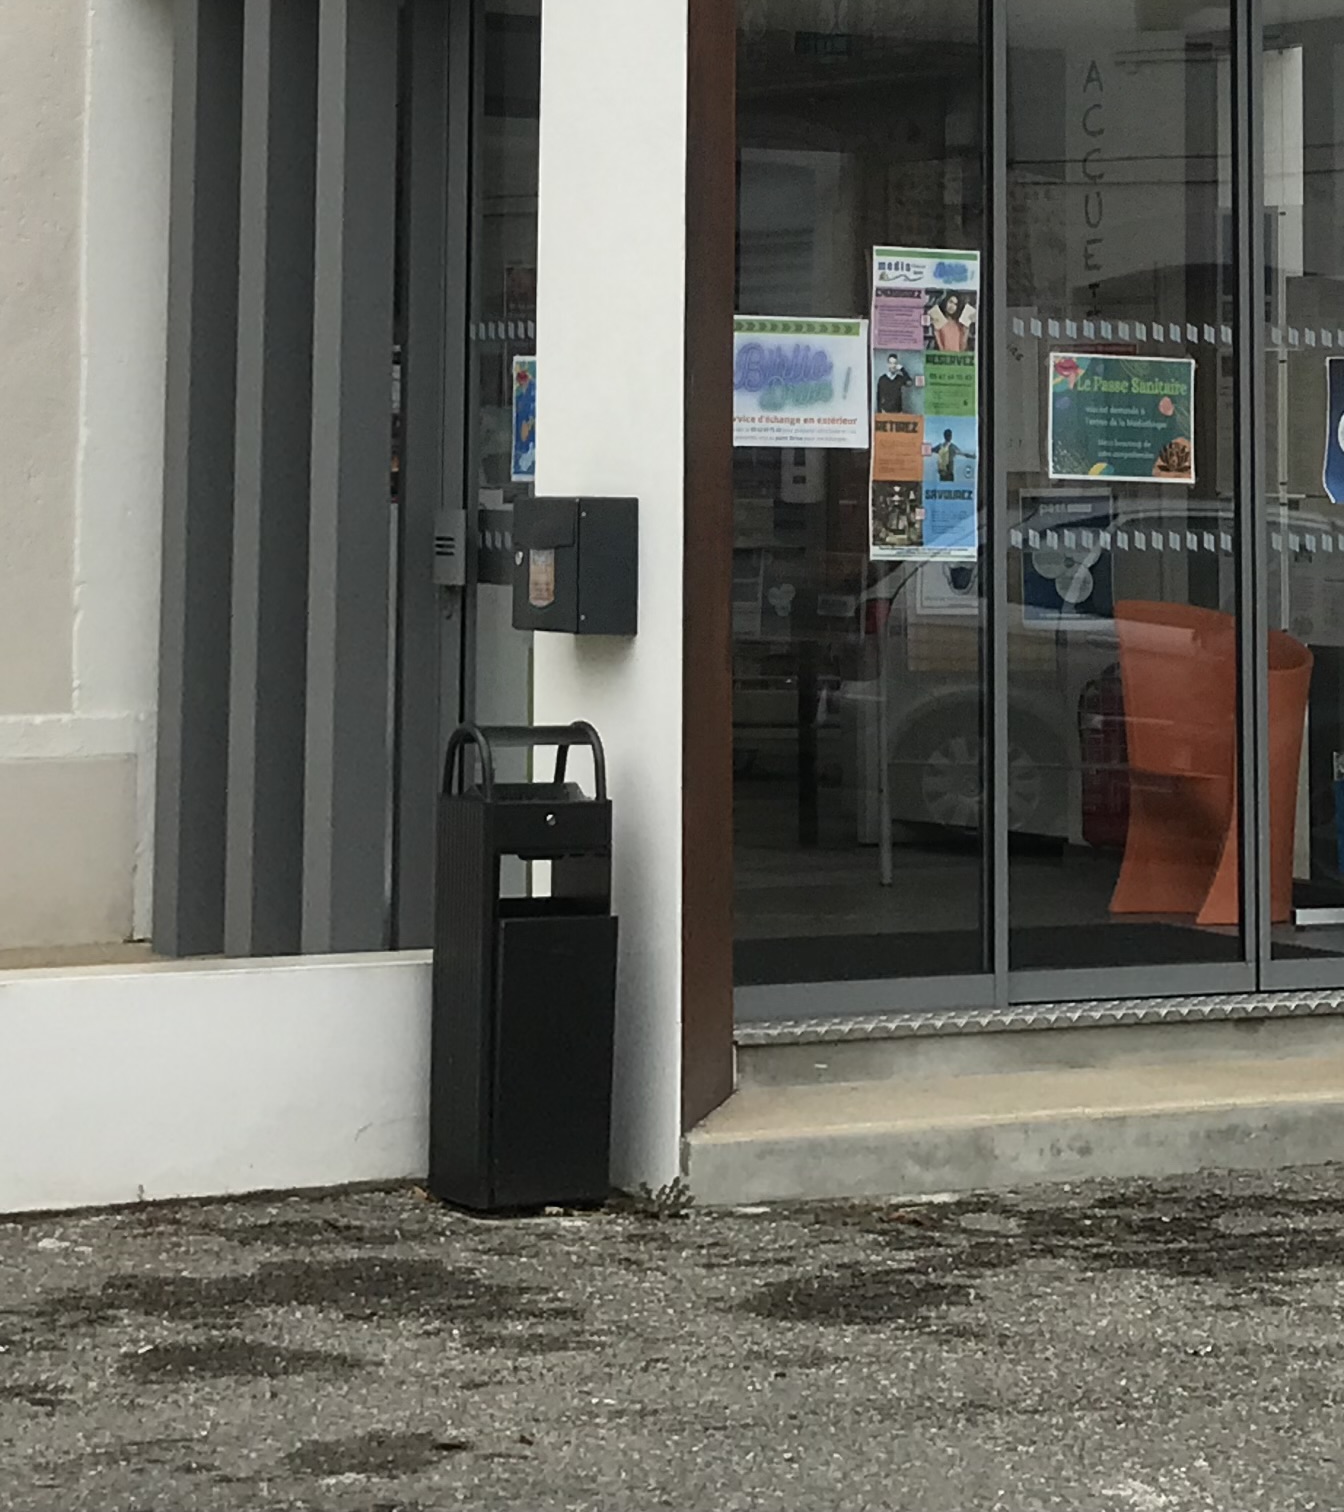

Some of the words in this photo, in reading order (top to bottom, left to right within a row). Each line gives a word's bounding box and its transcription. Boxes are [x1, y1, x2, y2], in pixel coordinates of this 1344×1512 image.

[1082, 59, 1105, 317] ACCUEI
[1076, 376, 1091, 391] Le
[1093, 376, 1128, 393] Passe
[1131, 377, 1187, 395] Sanitaire
[734, 416, 756, 424] vice
